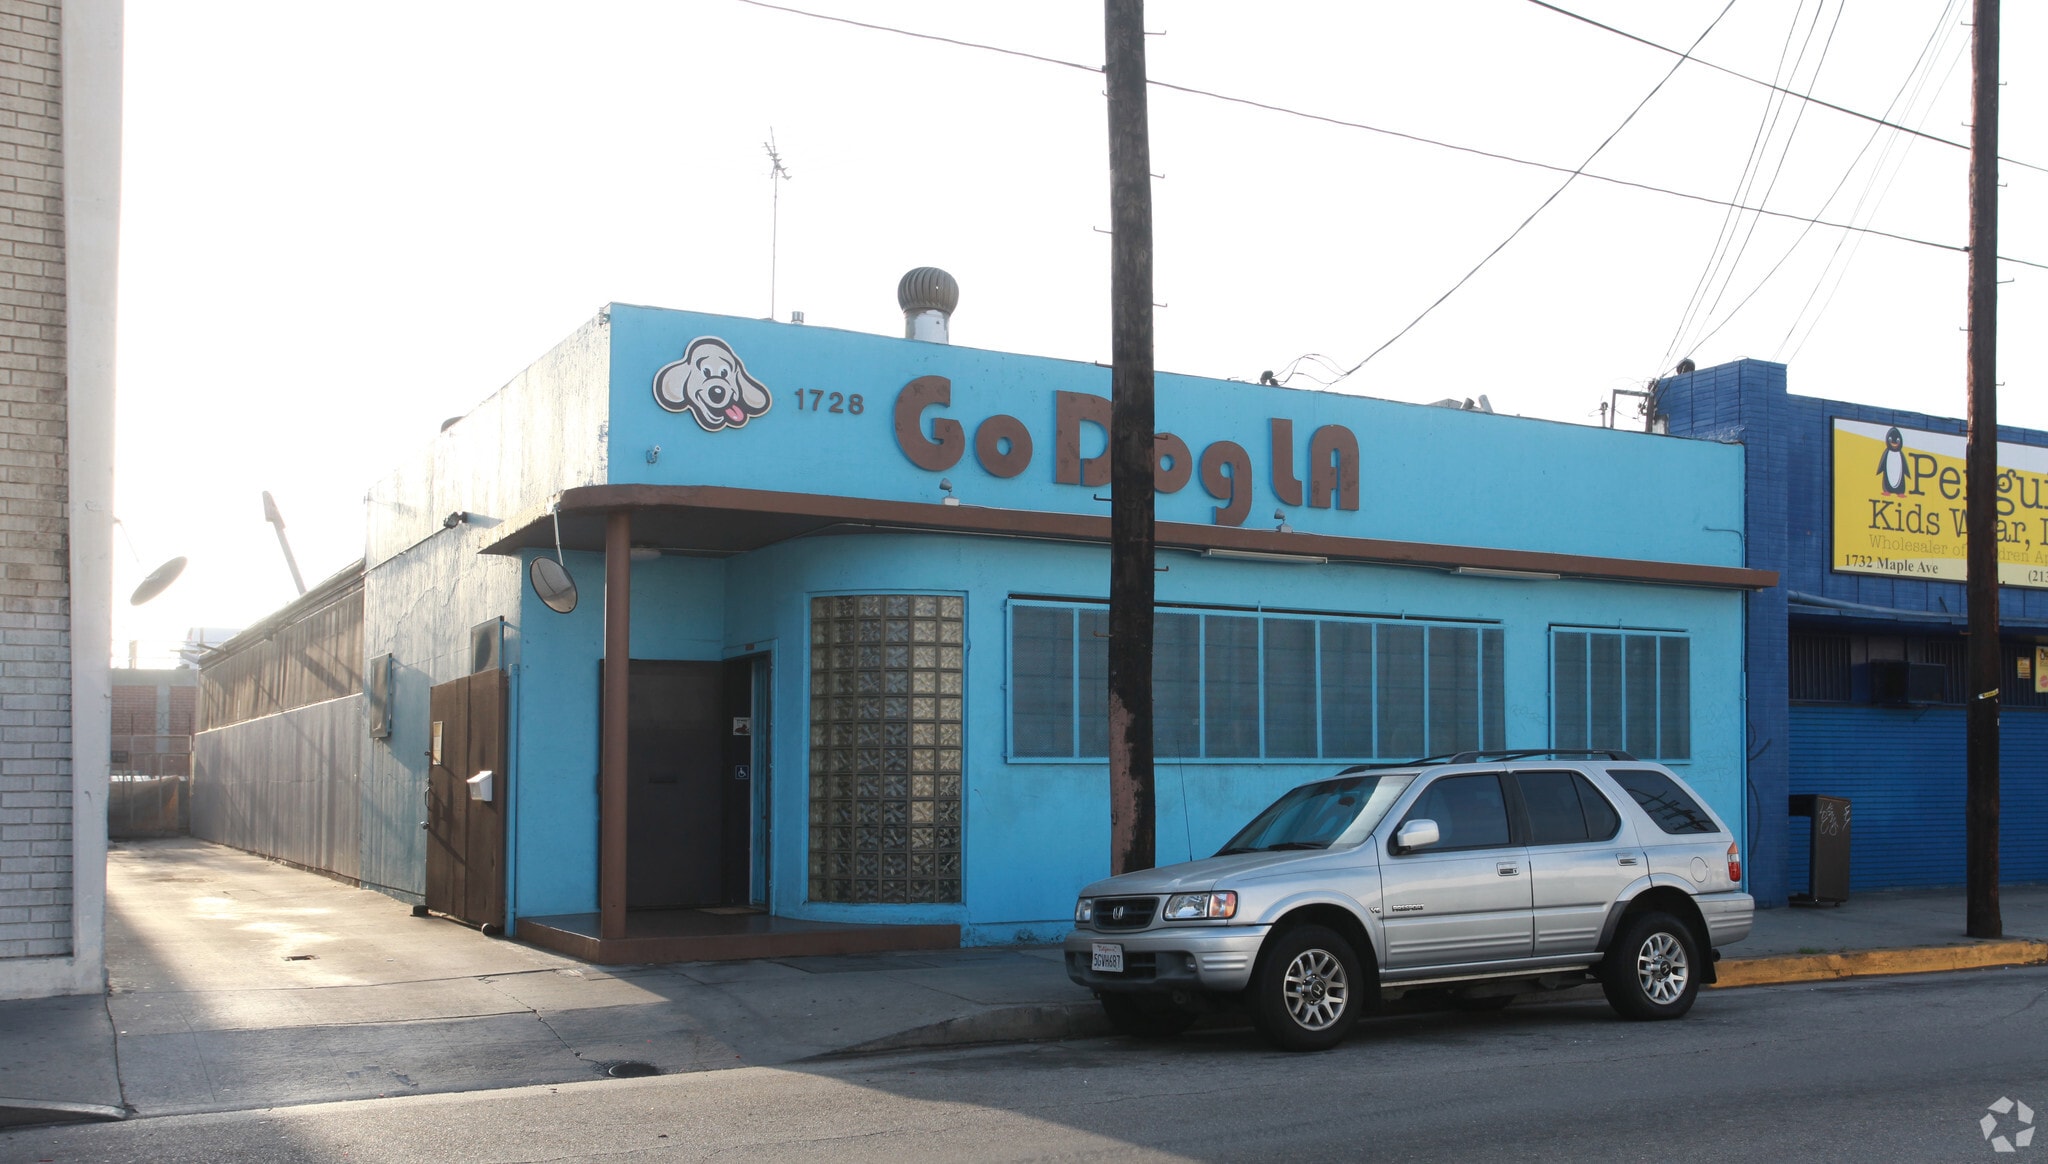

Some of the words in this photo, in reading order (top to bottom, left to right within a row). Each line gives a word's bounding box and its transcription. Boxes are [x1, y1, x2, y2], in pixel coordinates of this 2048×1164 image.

[795, 387, 864, 415] 1728
[894, 374, 1033, 478] Go
[1053, 389, 1253, 526] Dog
[1270, 416, 1360, 511] LA
[1868, 498, 1941, 536] Kids
[1948, 507, 2030, 551] War,
[1868, 534, 1949, 556] Wholesaler
[1844, 554, 1873, 568] 1732
[1876, 557, 1914, 574] Maple
[1916, 561, 1939, 574] Ave
